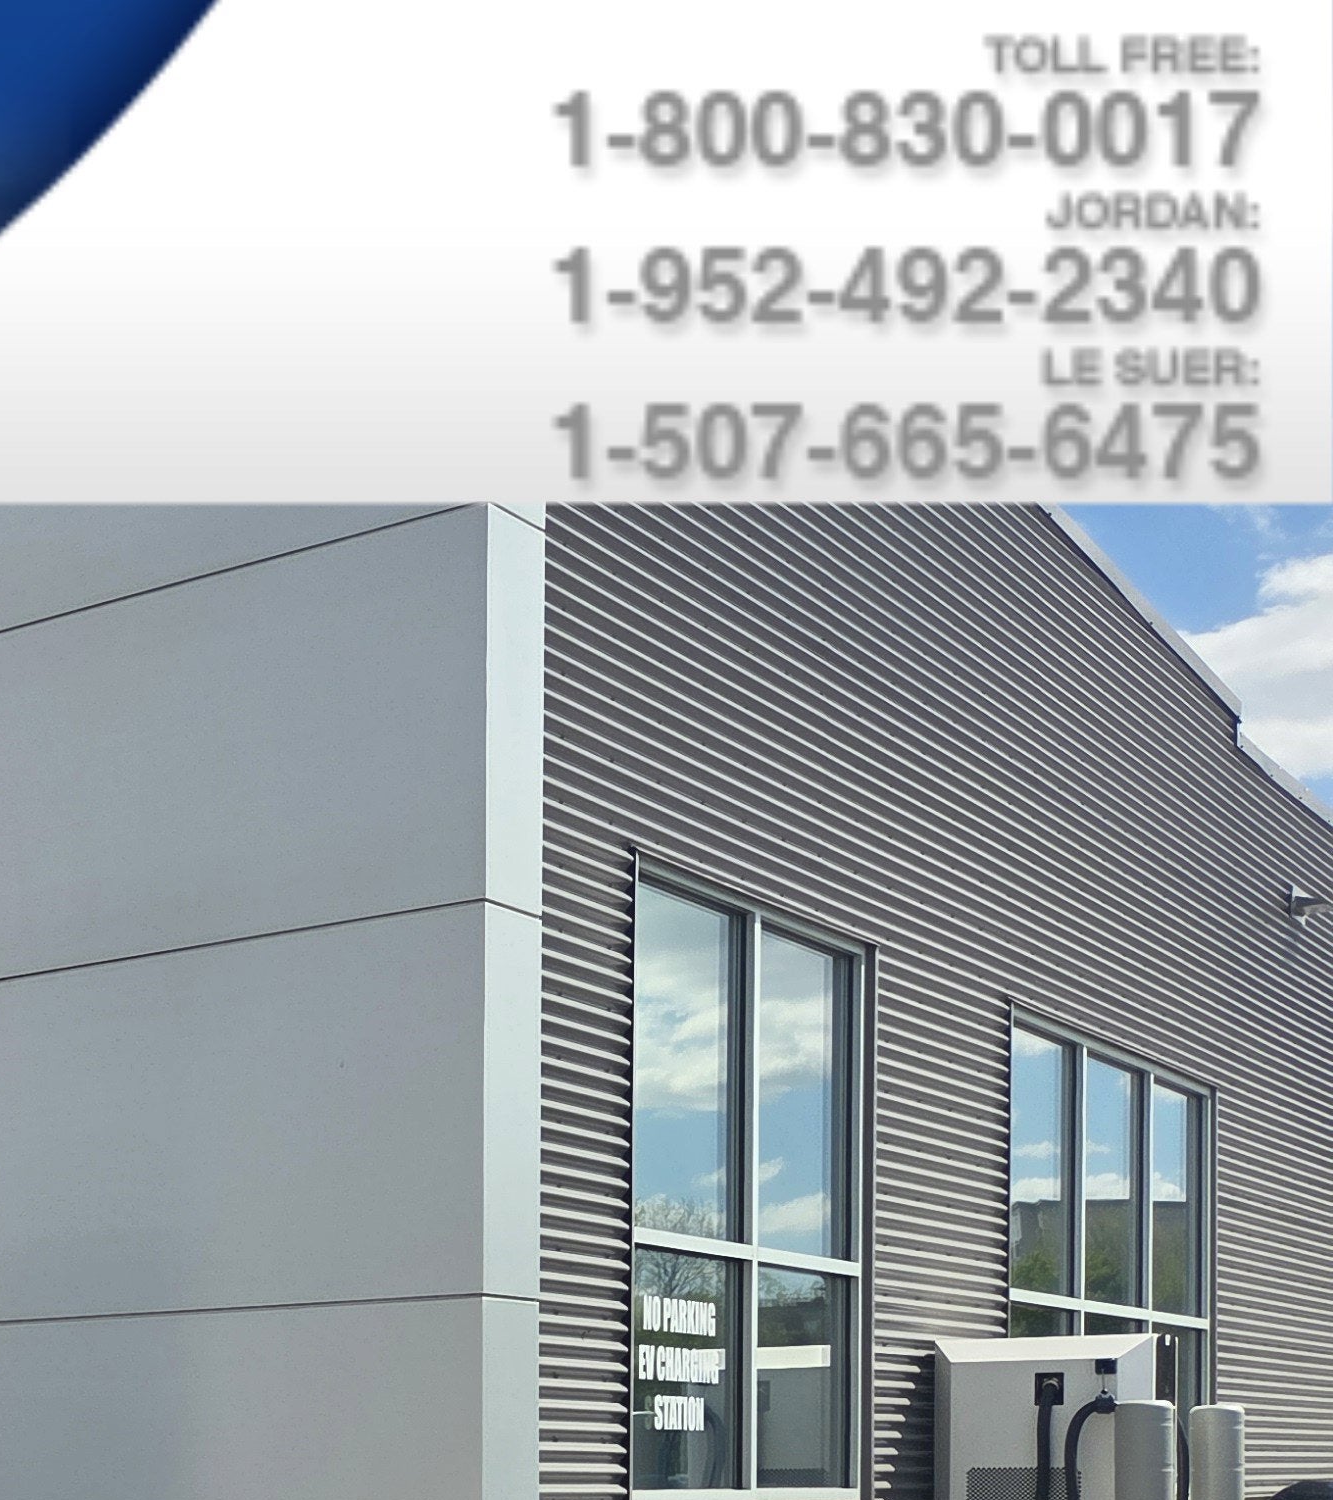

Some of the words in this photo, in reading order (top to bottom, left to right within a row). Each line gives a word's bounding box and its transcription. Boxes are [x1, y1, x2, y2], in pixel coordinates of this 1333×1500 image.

[643, 1295, 661, 1332] NO
[663, 1297, 717, 1337] PARKING
[638, 1344, 655, 1380] EV
[656, 1345, 720, 1384] CHARGING
[654, 1394, 705, 1431] STATION
